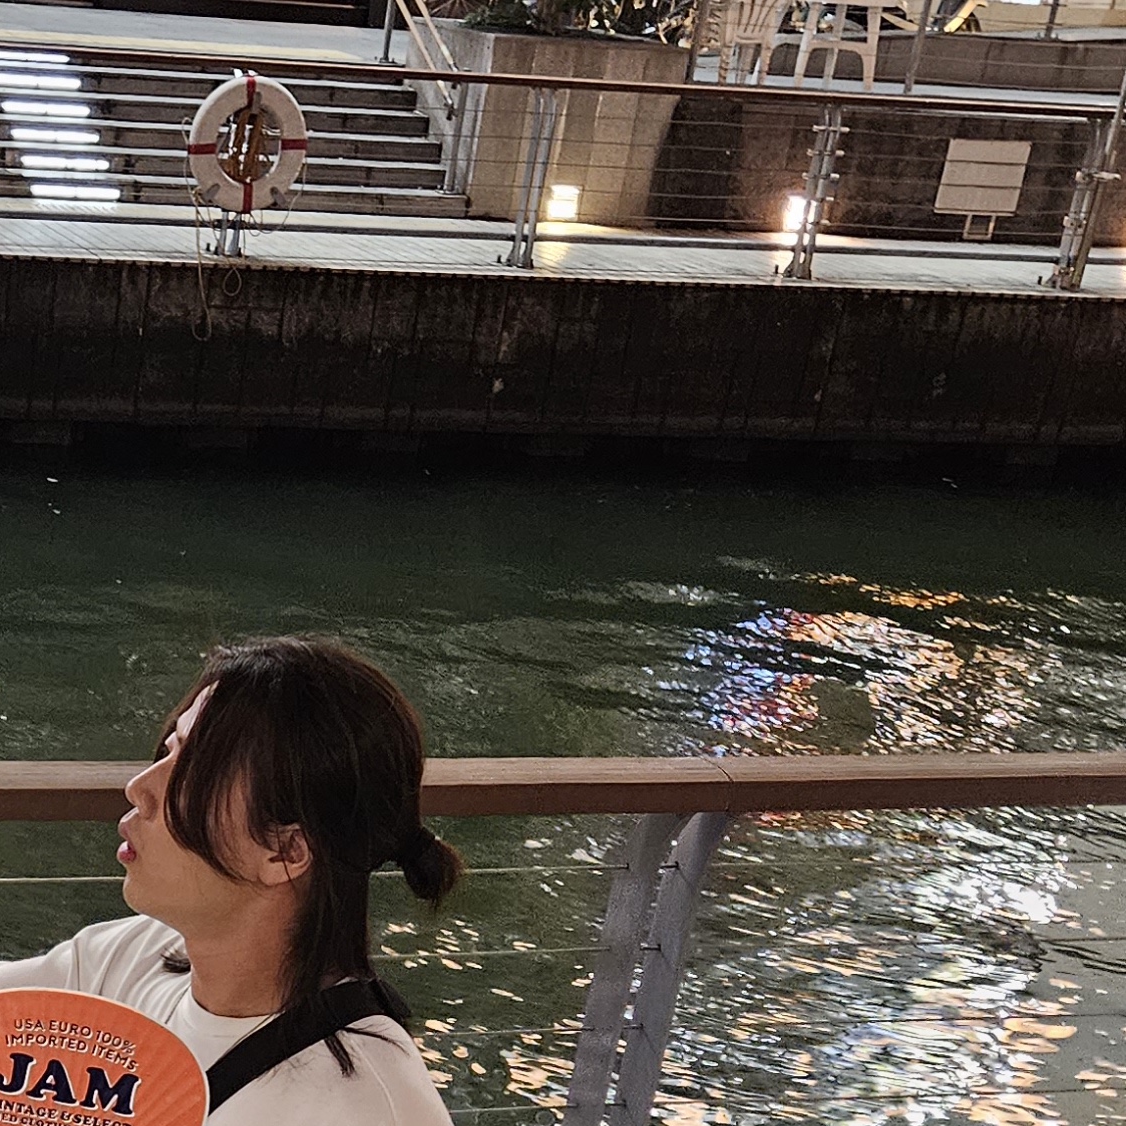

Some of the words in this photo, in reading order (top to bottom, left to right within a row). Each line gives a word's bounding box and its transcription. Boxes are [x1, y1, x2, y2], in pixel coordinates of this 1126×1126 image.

[5, 1034, 87, 1052] IMPORTED
[92, 1044, 138, 1071] ITEMS
[14, 1019, 45, 1031] USA
[49, 1020, 92, 1038] EURO
[96, 1030, 136, 1054] 100%
